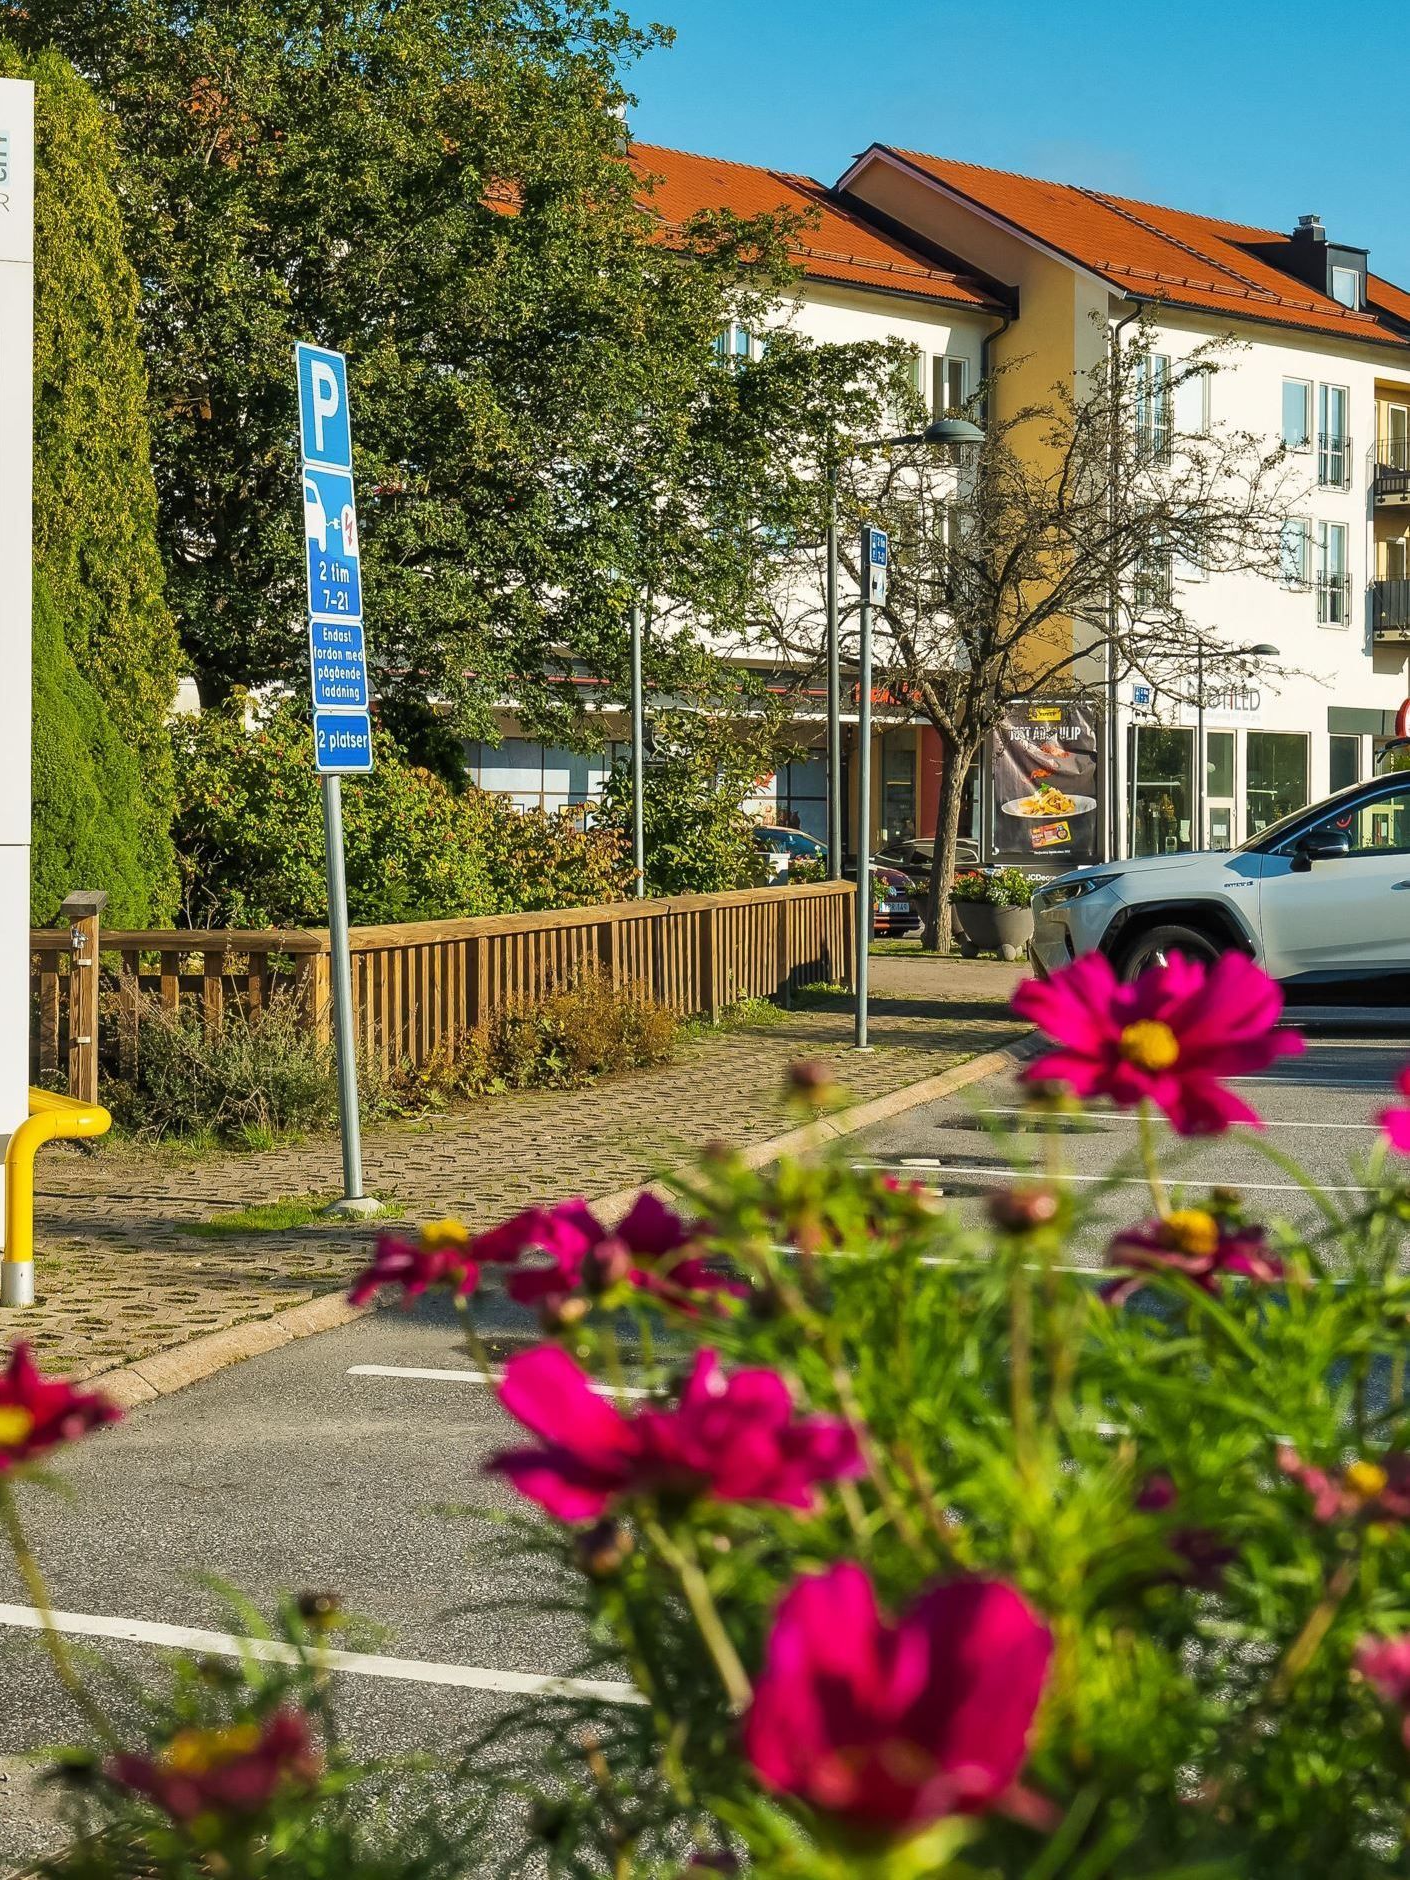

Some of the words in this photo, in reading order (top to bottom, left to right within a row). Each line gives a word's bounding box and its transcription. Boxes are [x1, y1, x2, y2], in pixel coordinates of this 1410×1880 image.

[311, 359, 339, 452] P
[319, 560, 327, 581] 2
[331, 563, 350, 583] tim
[323, 589, 349, 611] 7-21
[322, 627, 352, 643] Endast
[314, 646, 343, 661] fordon
[345, 649, 363, 662] med
[318, 664, 361, 682] pågående
[321, 683, 360, 702] laddning
[318, 729, 326, 748] 2
[329, 730, 368, 753] platser
[1053, 726, 1081, 741] ULIP
